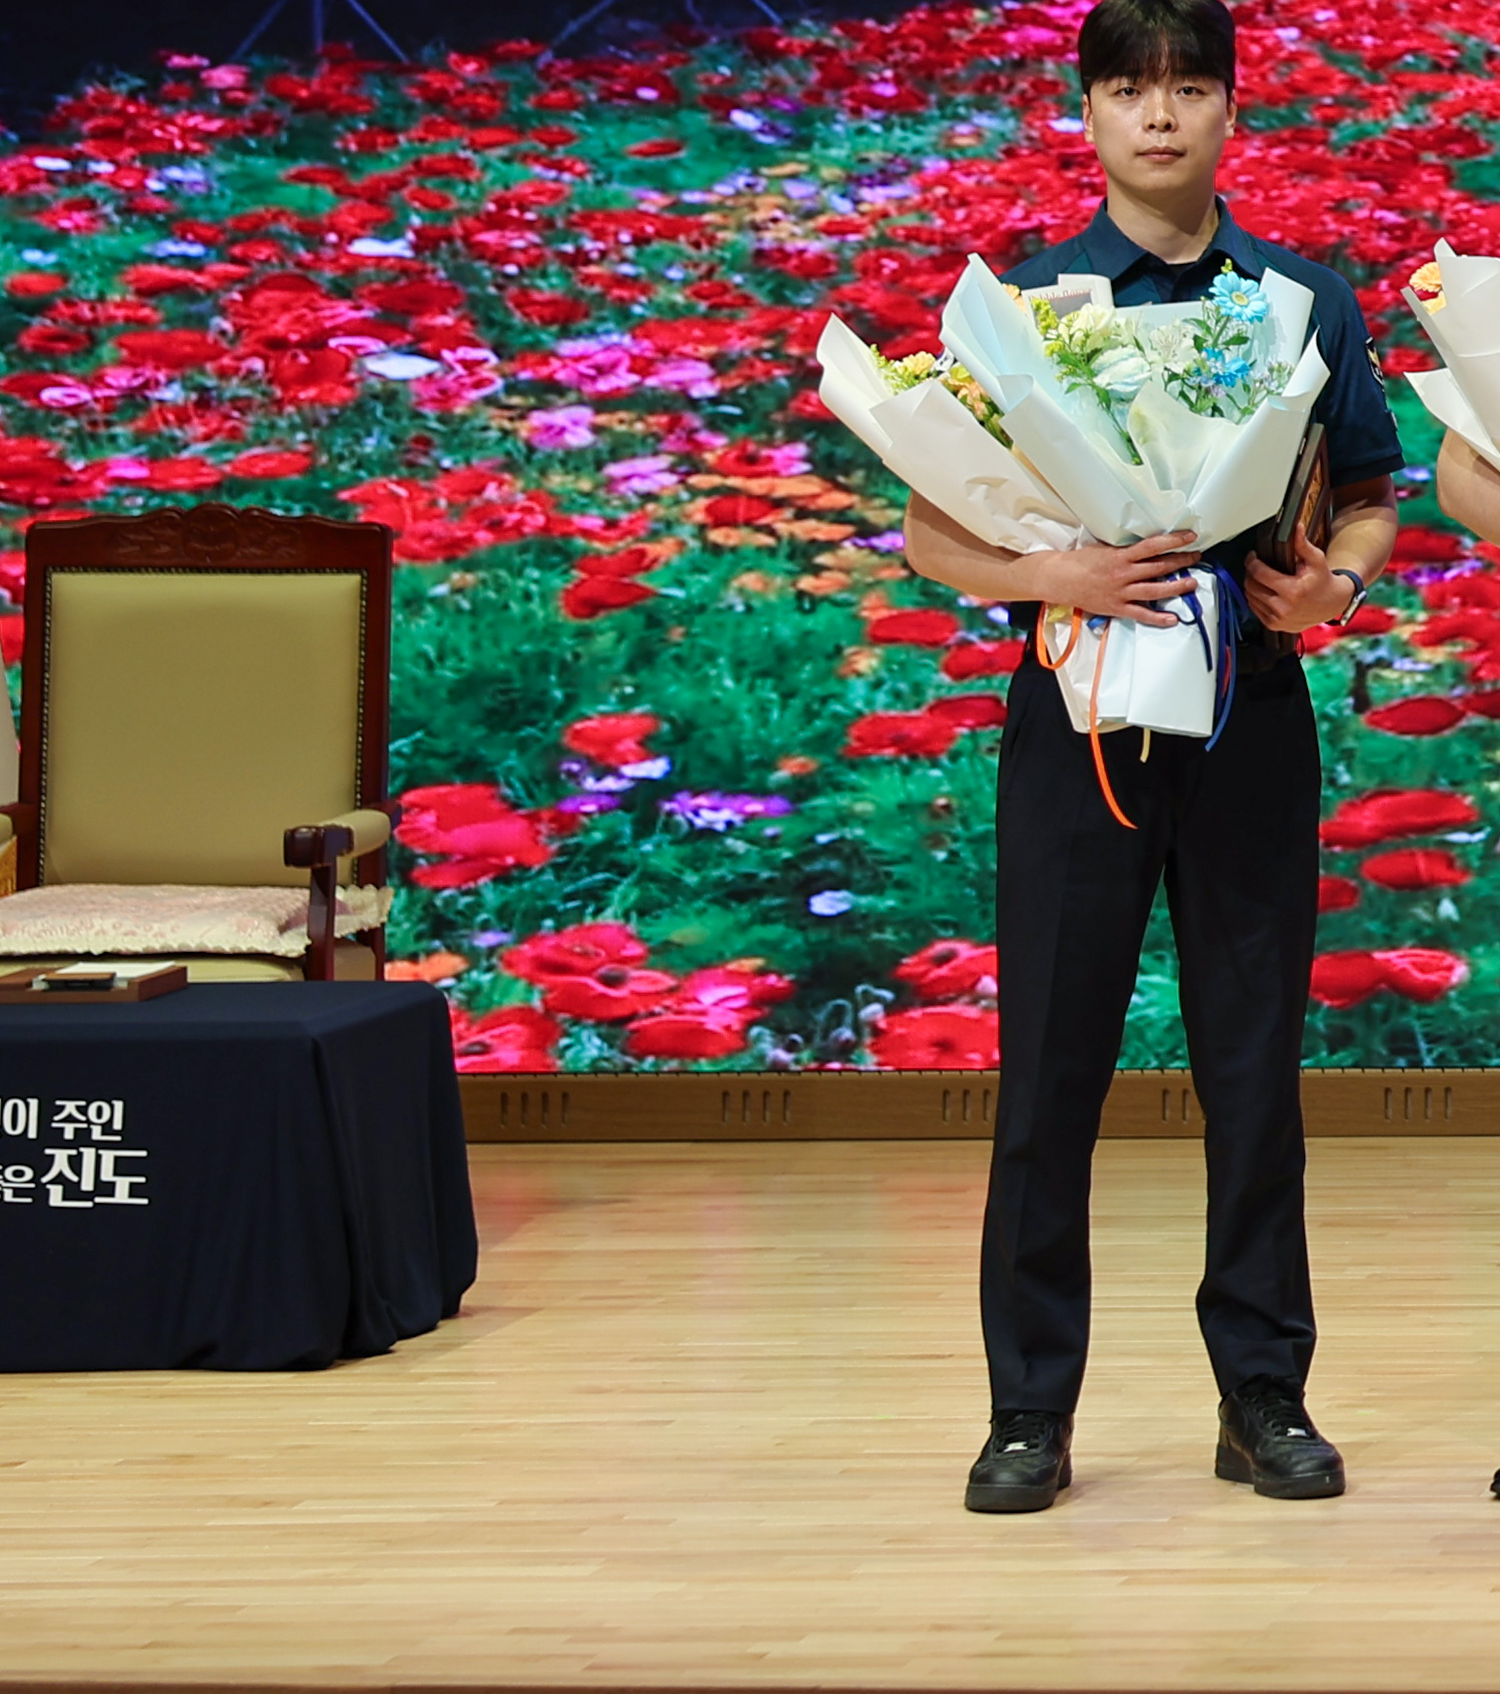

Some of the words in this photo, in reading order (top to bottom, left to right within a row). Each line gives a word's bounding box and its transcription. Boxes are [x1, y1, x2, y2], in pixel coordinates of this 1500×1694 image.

[0, 1097, 39, 1140] 이
[51, 1099, 124, 1142] 주인
[40, 1147, 149, 1208] 진도
